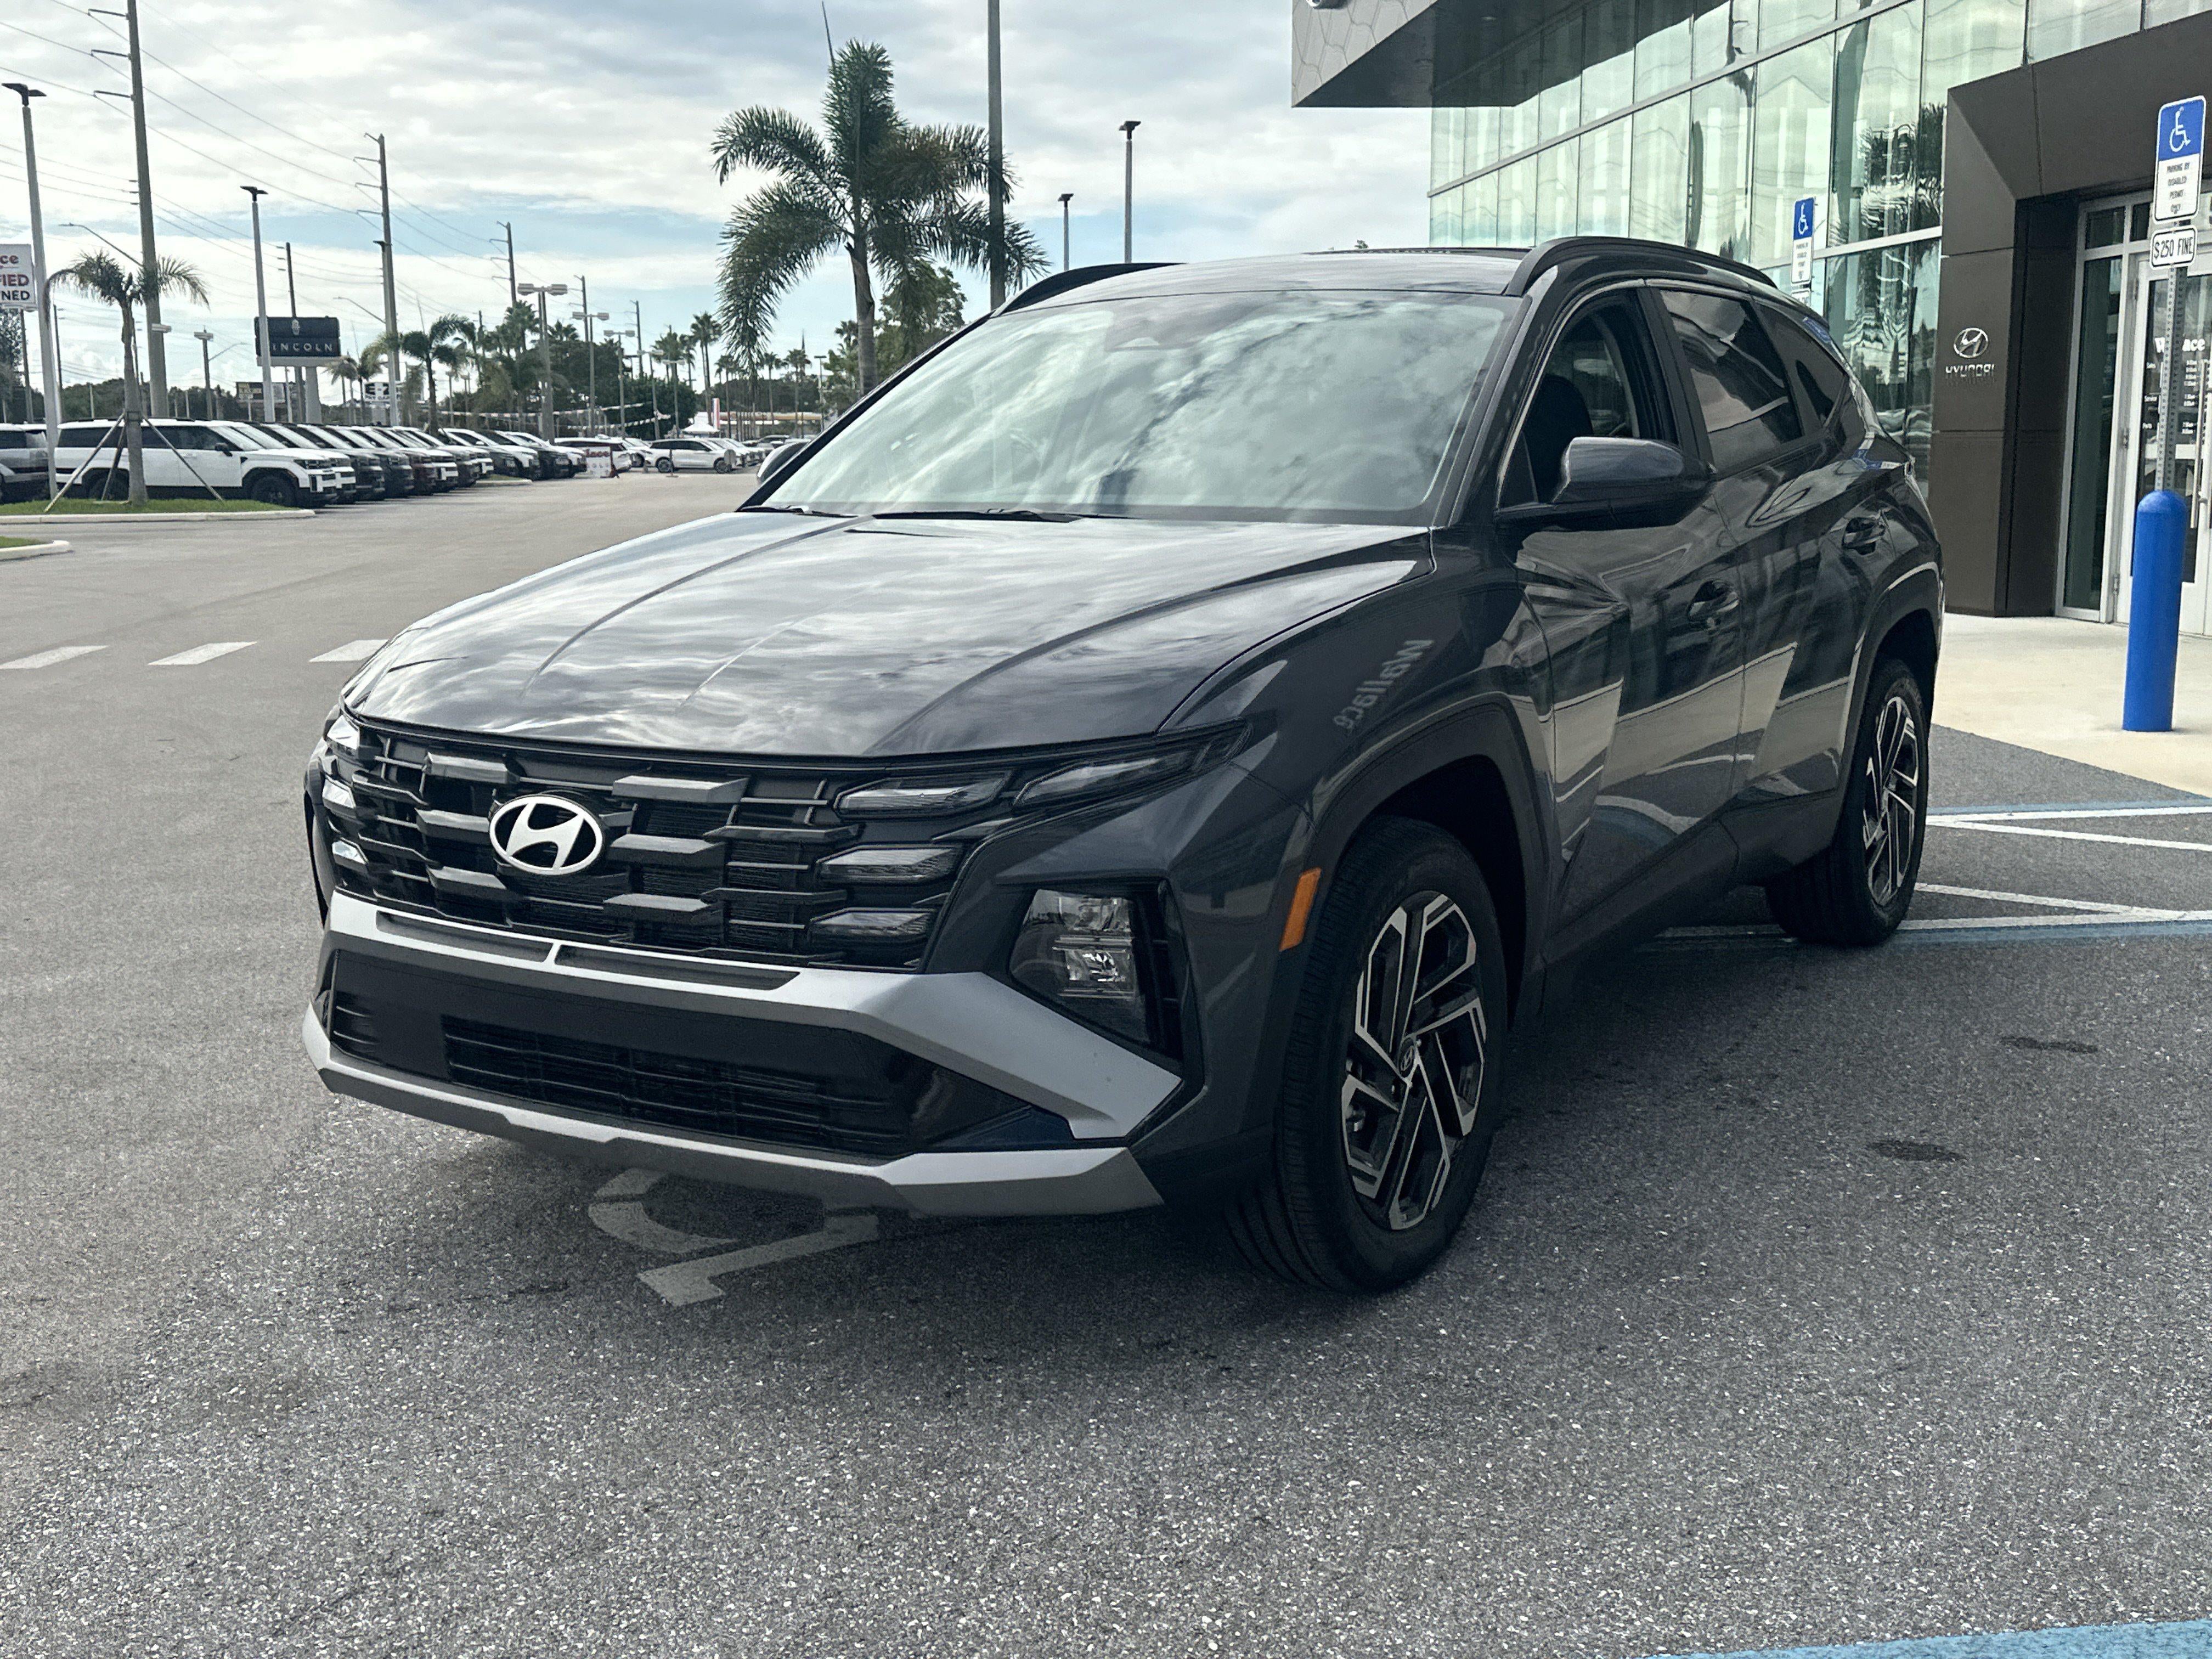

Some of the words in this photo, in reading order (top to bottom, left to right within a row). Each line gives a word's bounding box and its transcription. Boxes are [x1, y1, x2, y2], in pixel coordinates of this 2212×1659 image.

[2153, 239, 2174, 259] $250
[2177, 236, 2194, 256] FINE
[0, 274, 29, 286] IED
[272, 342, 332, 352] INCOLN
